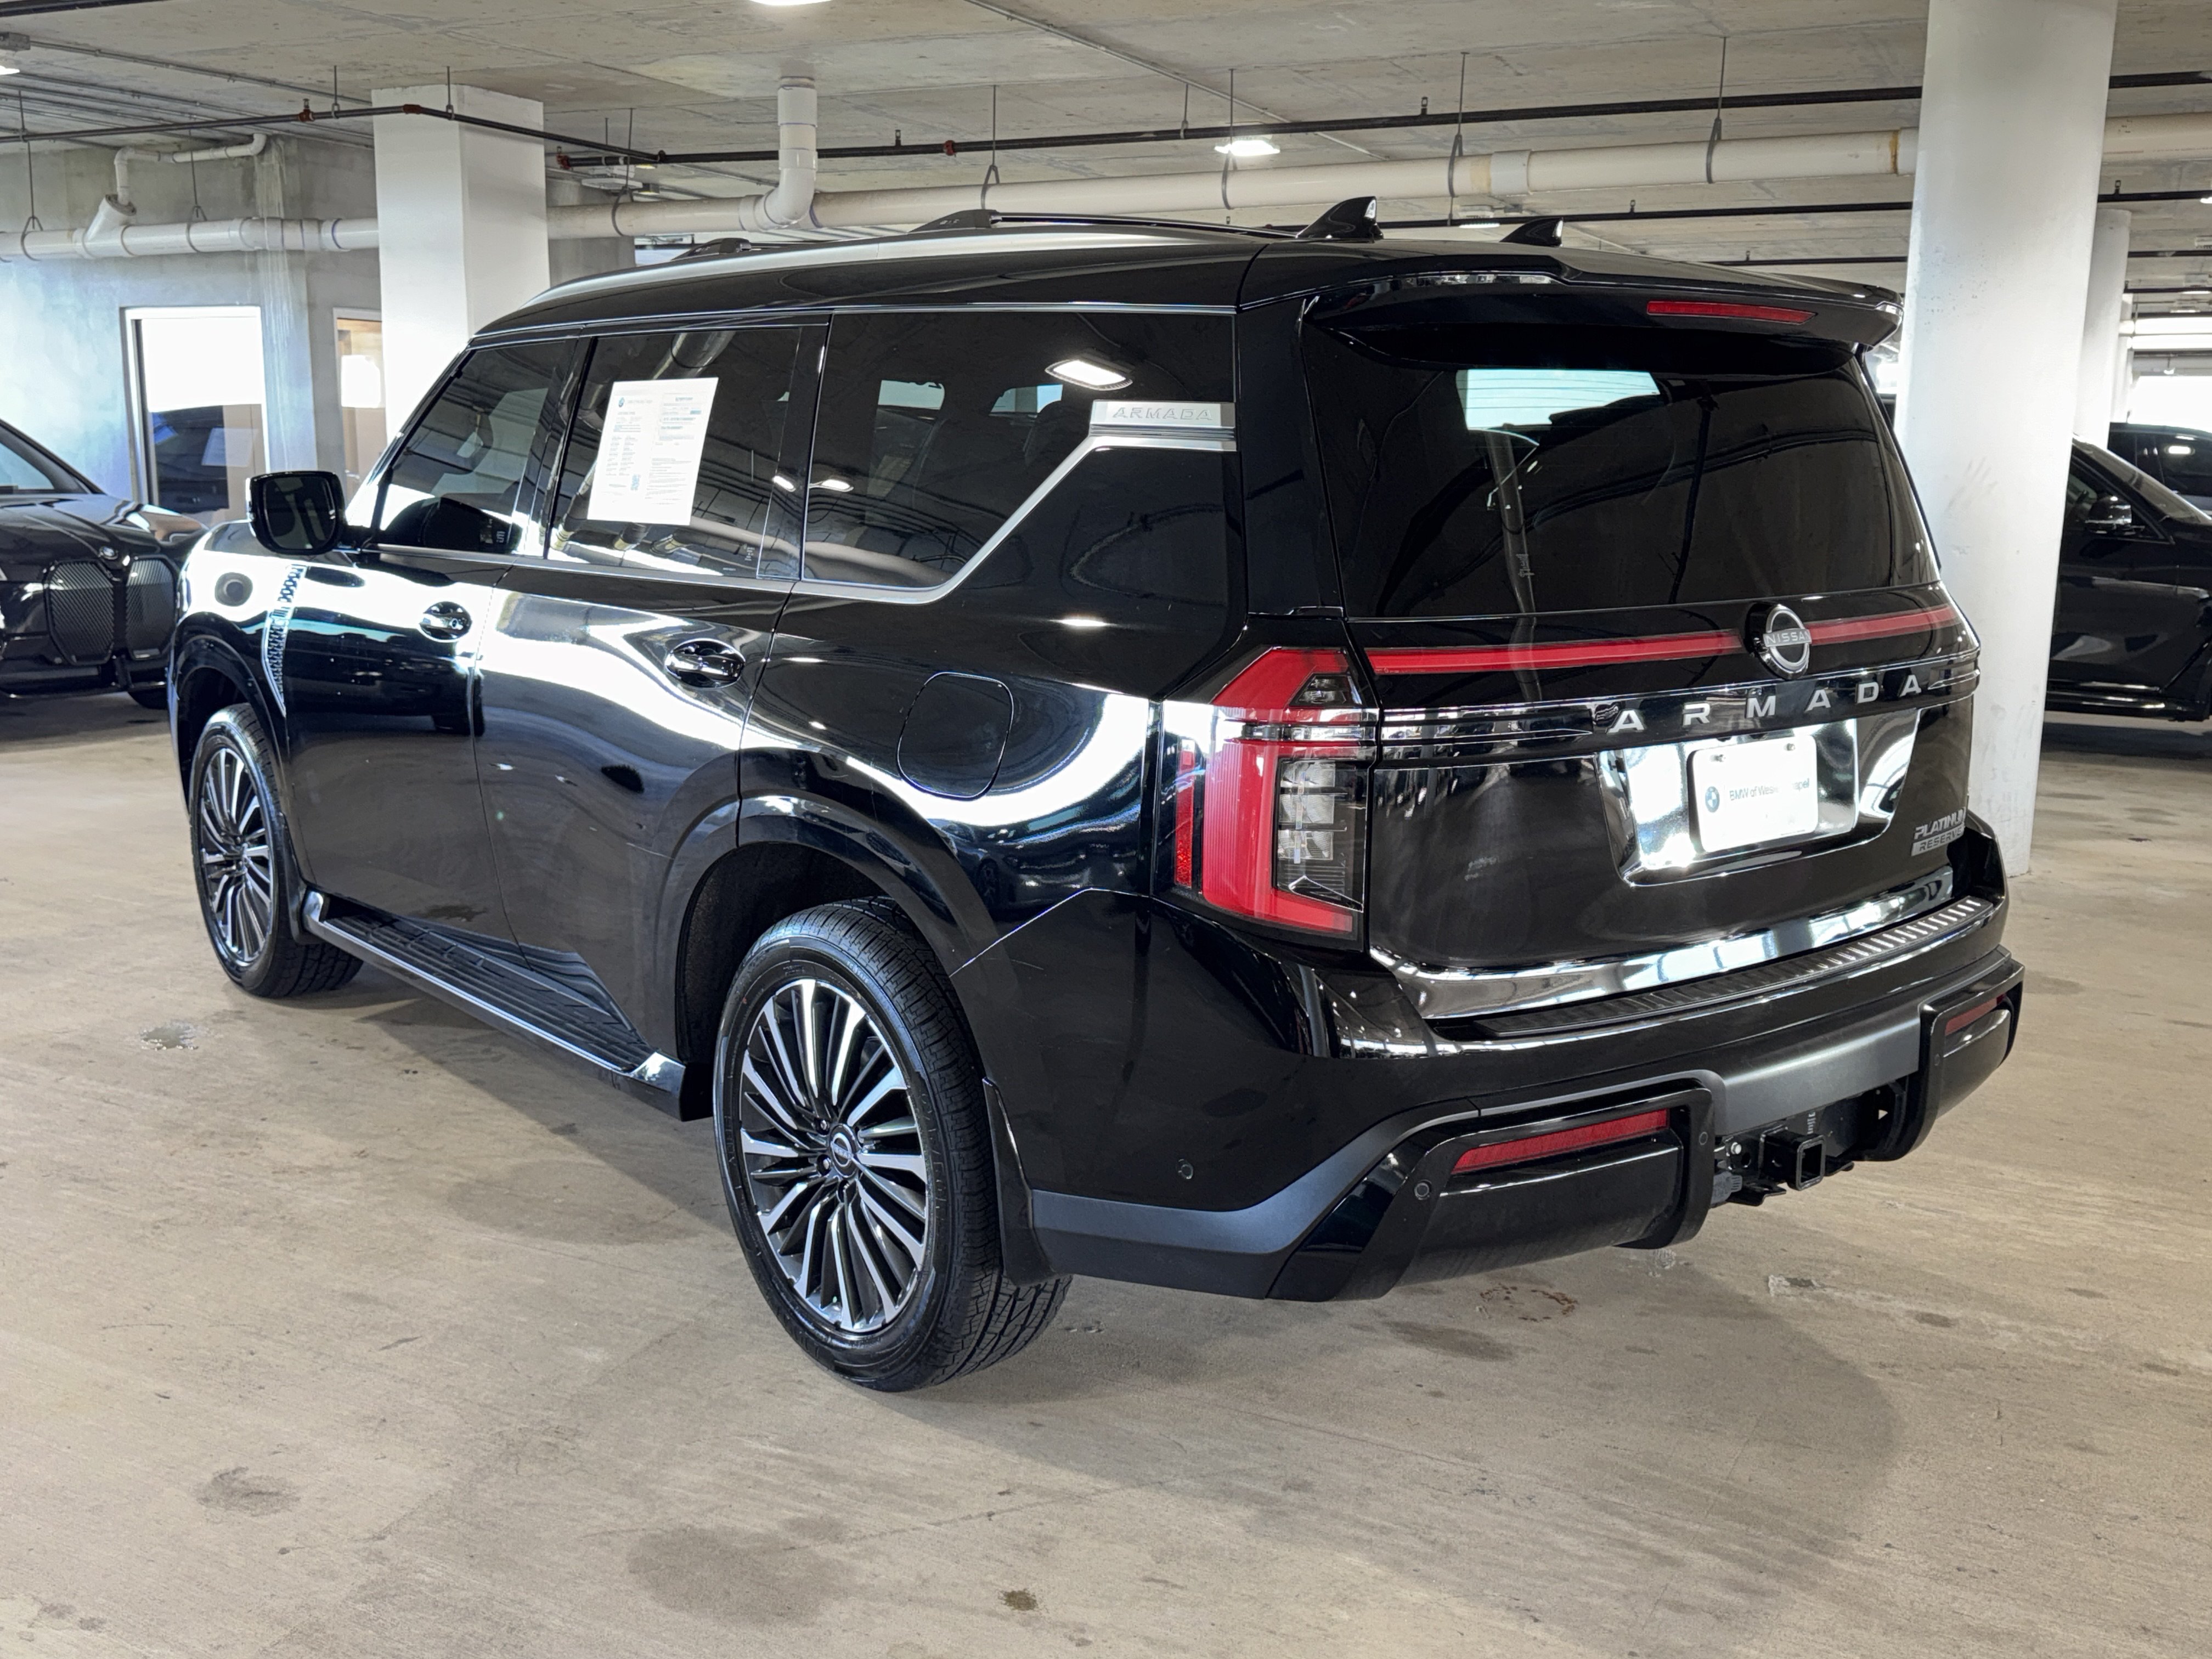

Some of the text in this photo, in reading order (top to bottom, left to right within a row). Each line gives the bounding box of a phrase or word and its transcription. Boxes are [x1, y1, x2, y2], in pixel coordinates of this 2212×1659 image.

[1113, 407, 1213, 421] ARMADA
[1765, 630, 1810, 644] NISSAN
[1606, 674, 1922, 733] ARMADA
[1729, 787, 1748, 801] BMW
[1750, 786, 1758, 797] of
[1920, 826, 1963, 852] RESERVE
